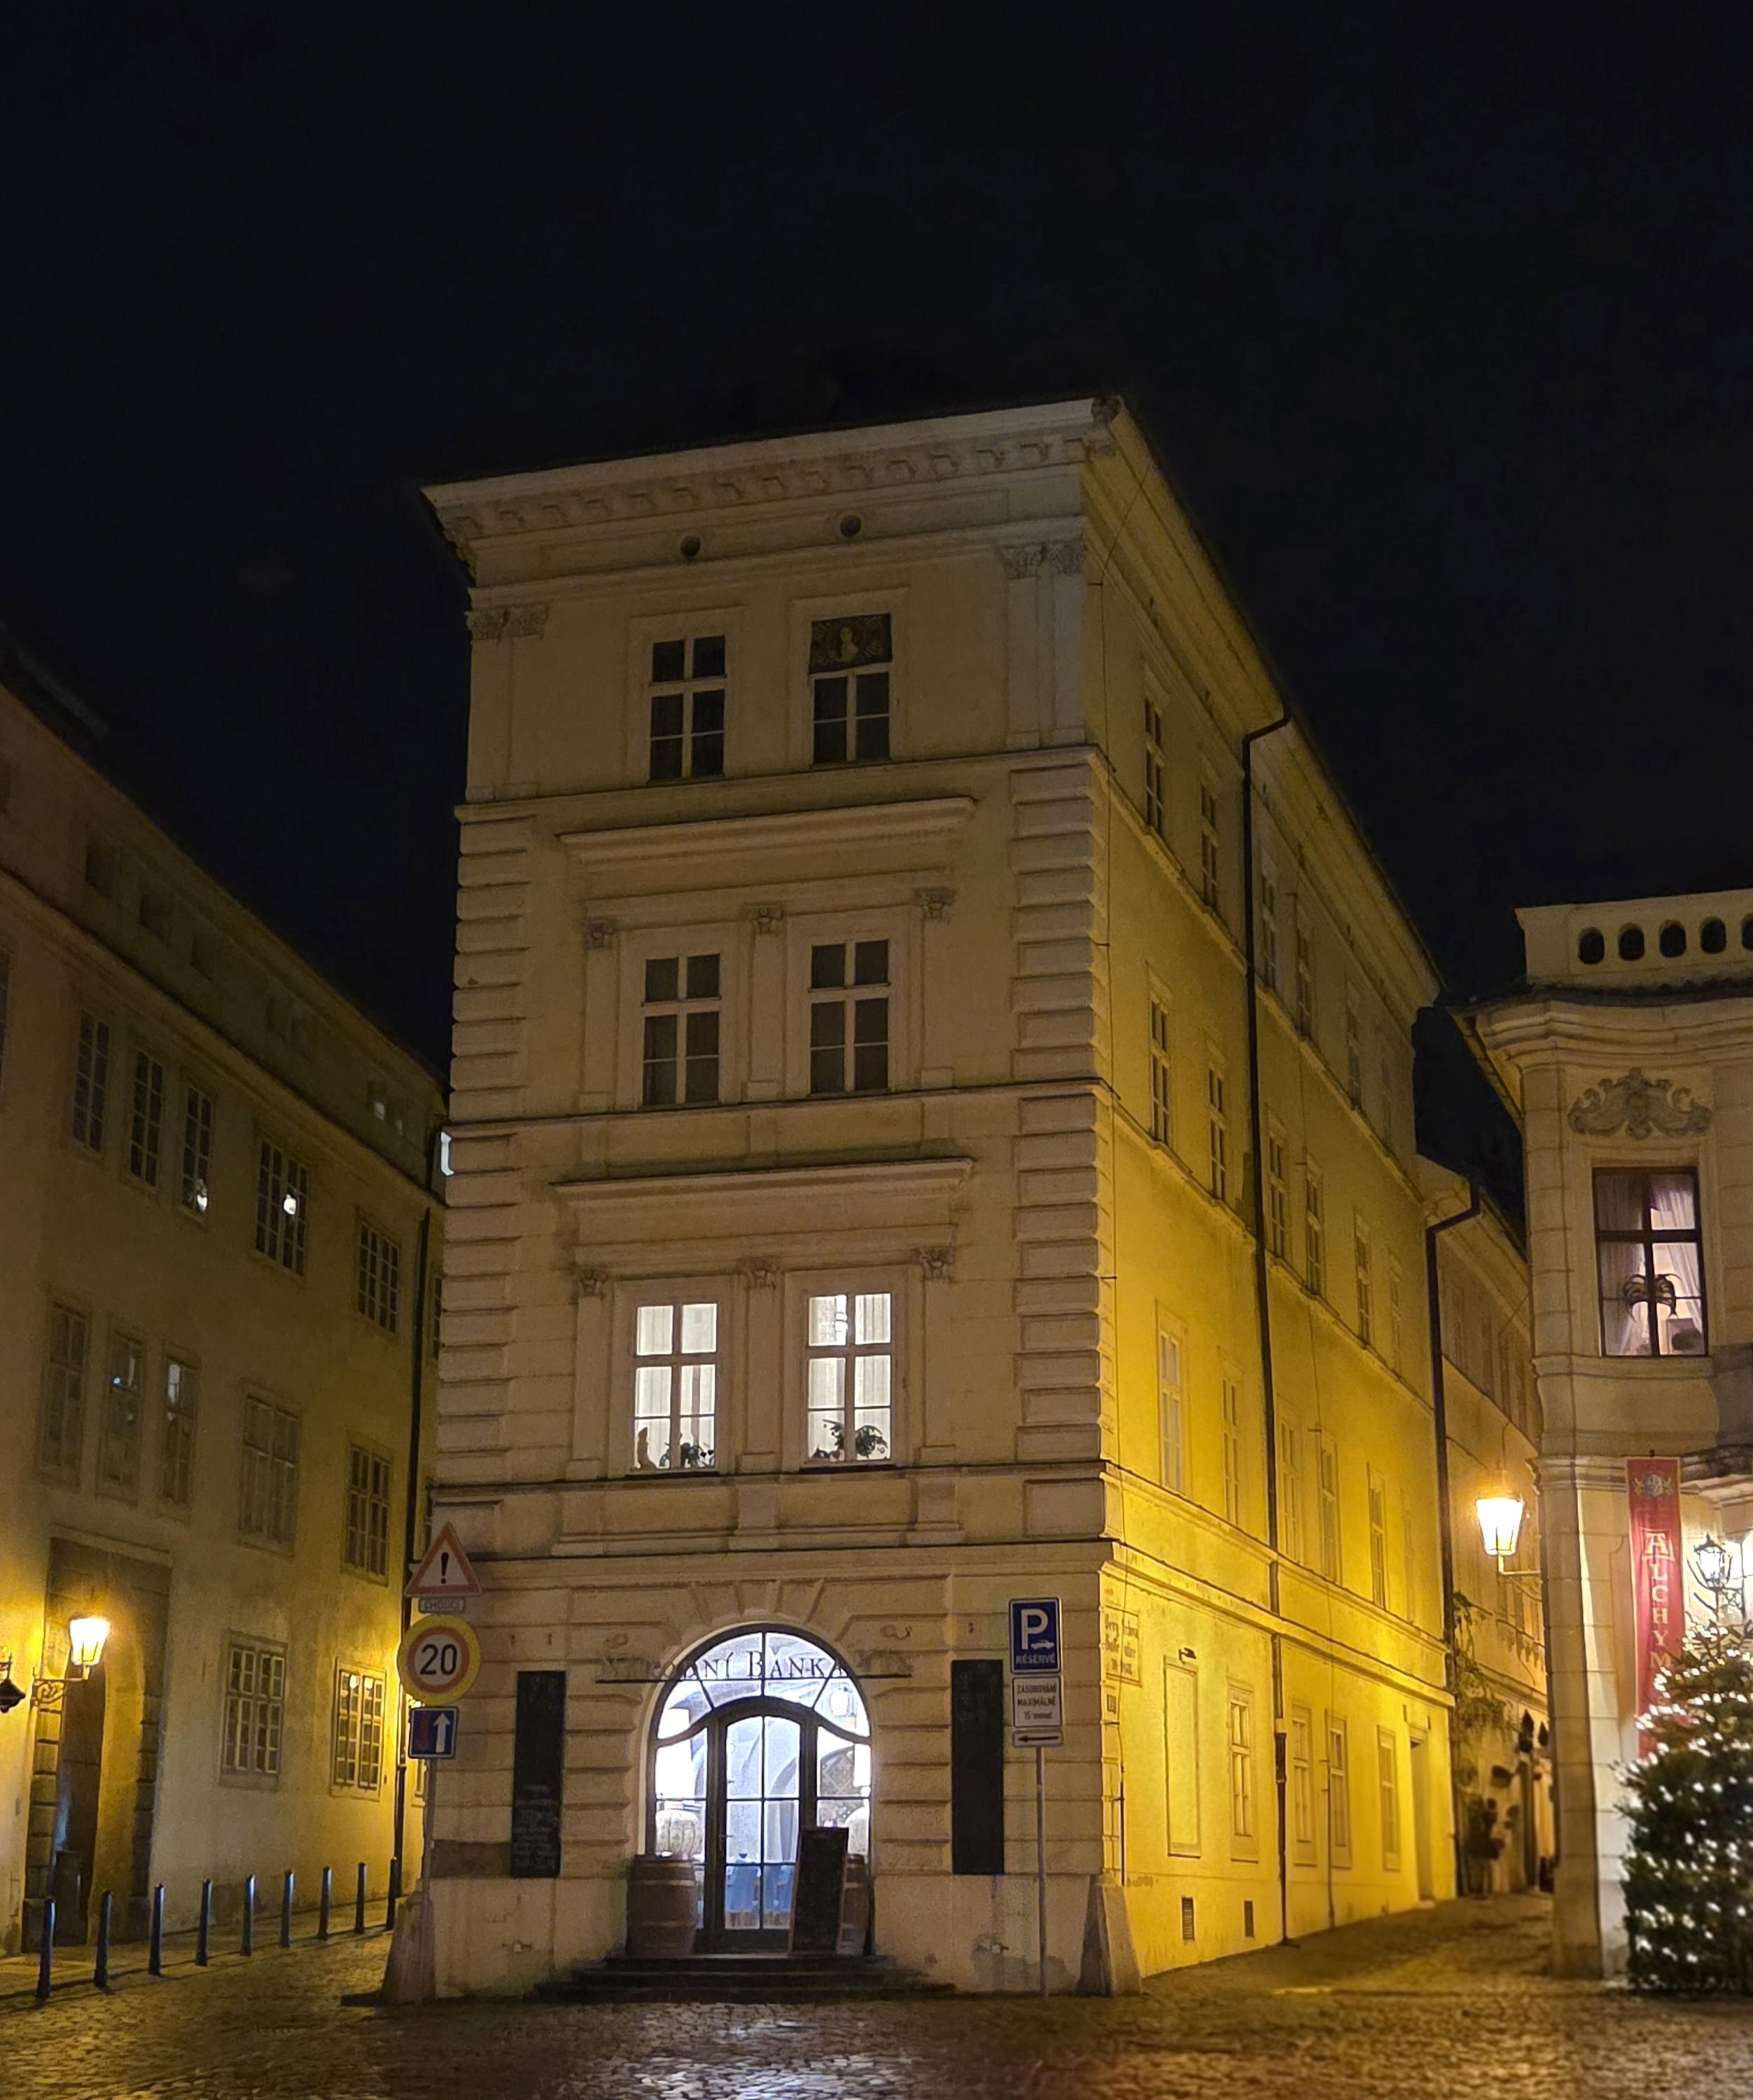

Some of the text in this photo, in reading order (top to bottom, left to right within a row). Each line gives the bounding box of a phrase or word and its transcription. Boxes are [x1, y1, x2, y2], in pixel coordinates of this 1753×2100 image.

[1021, 1609, 1048, 1649] P
[420, 1644, 457, 1675] 20
[1015, 1653, 1056, 1665] RÉSERVÉ
